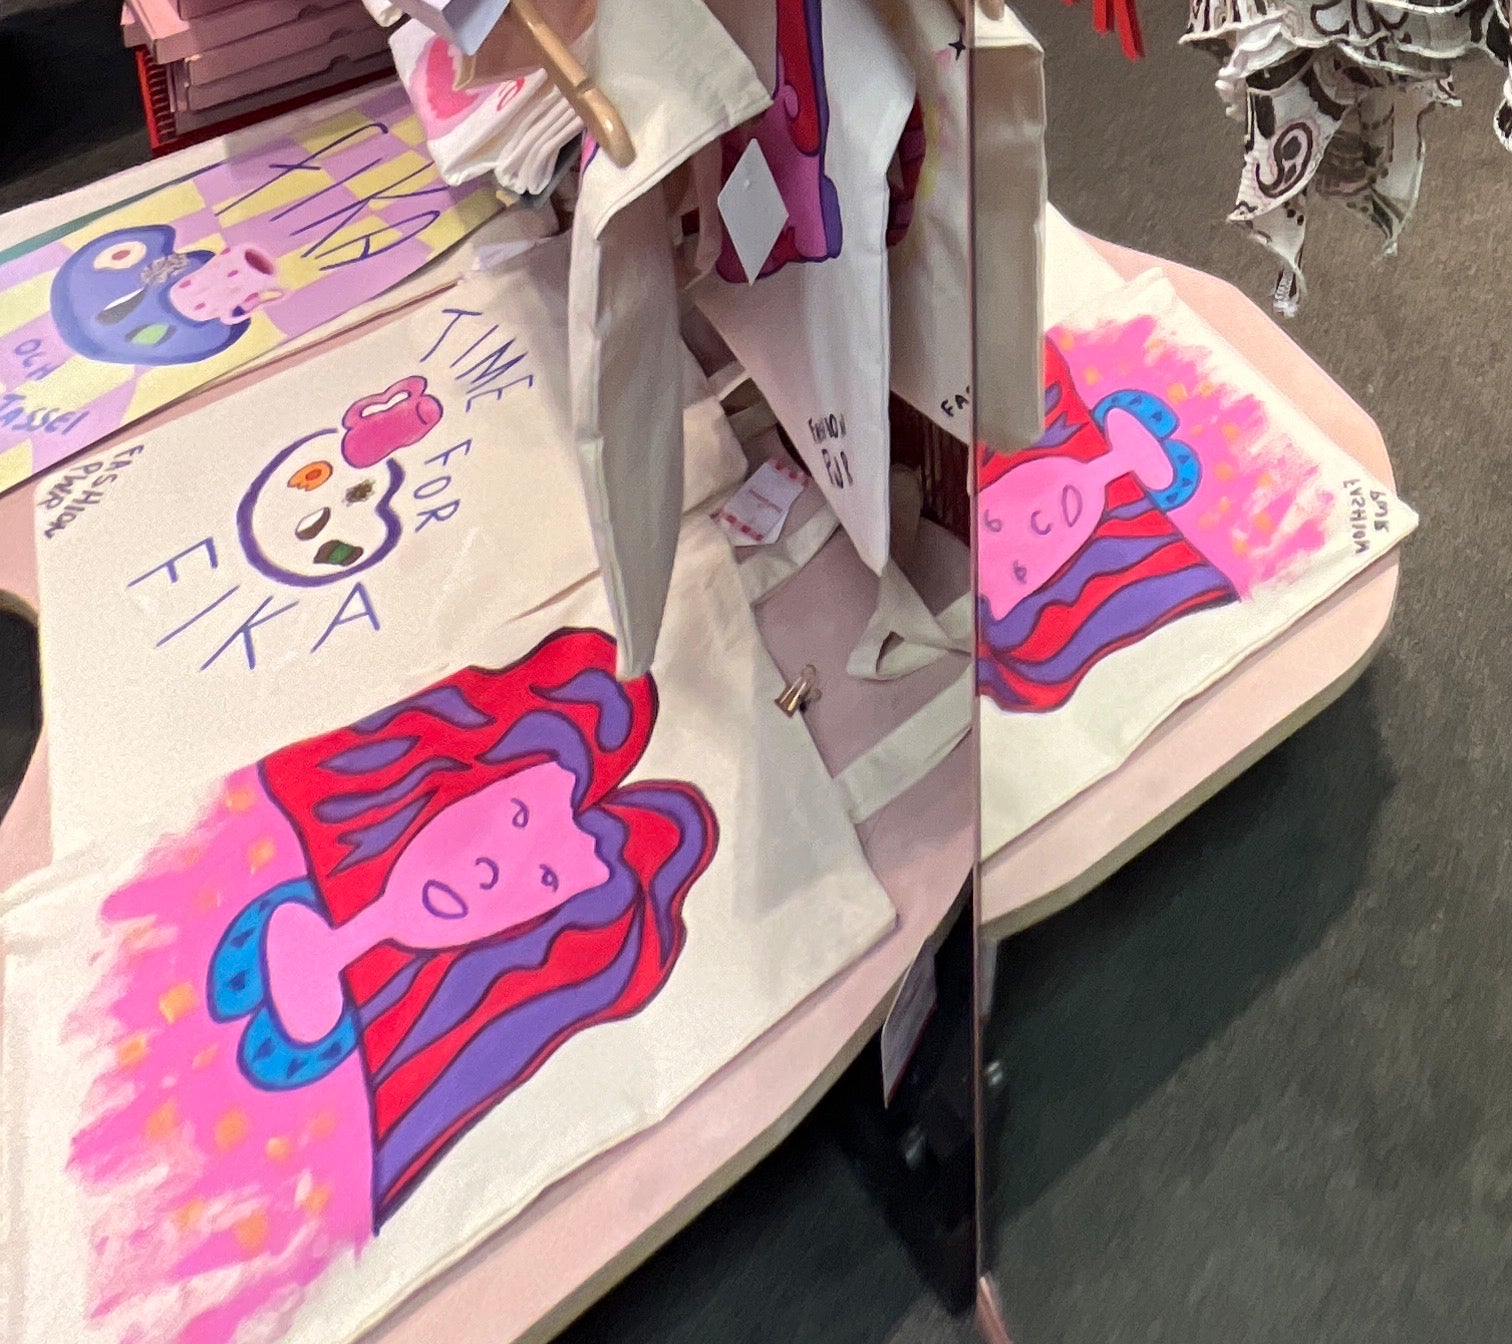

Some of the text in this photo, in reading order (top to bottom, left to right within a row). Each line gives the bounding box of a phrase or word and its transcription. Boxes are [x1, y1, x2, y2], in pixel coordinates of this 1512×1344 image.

[37, 461, 104, 510] PWR
[44, 443, 145, 540] FASHION
[126, 308, 534, 672] TIME FOR FIKA
